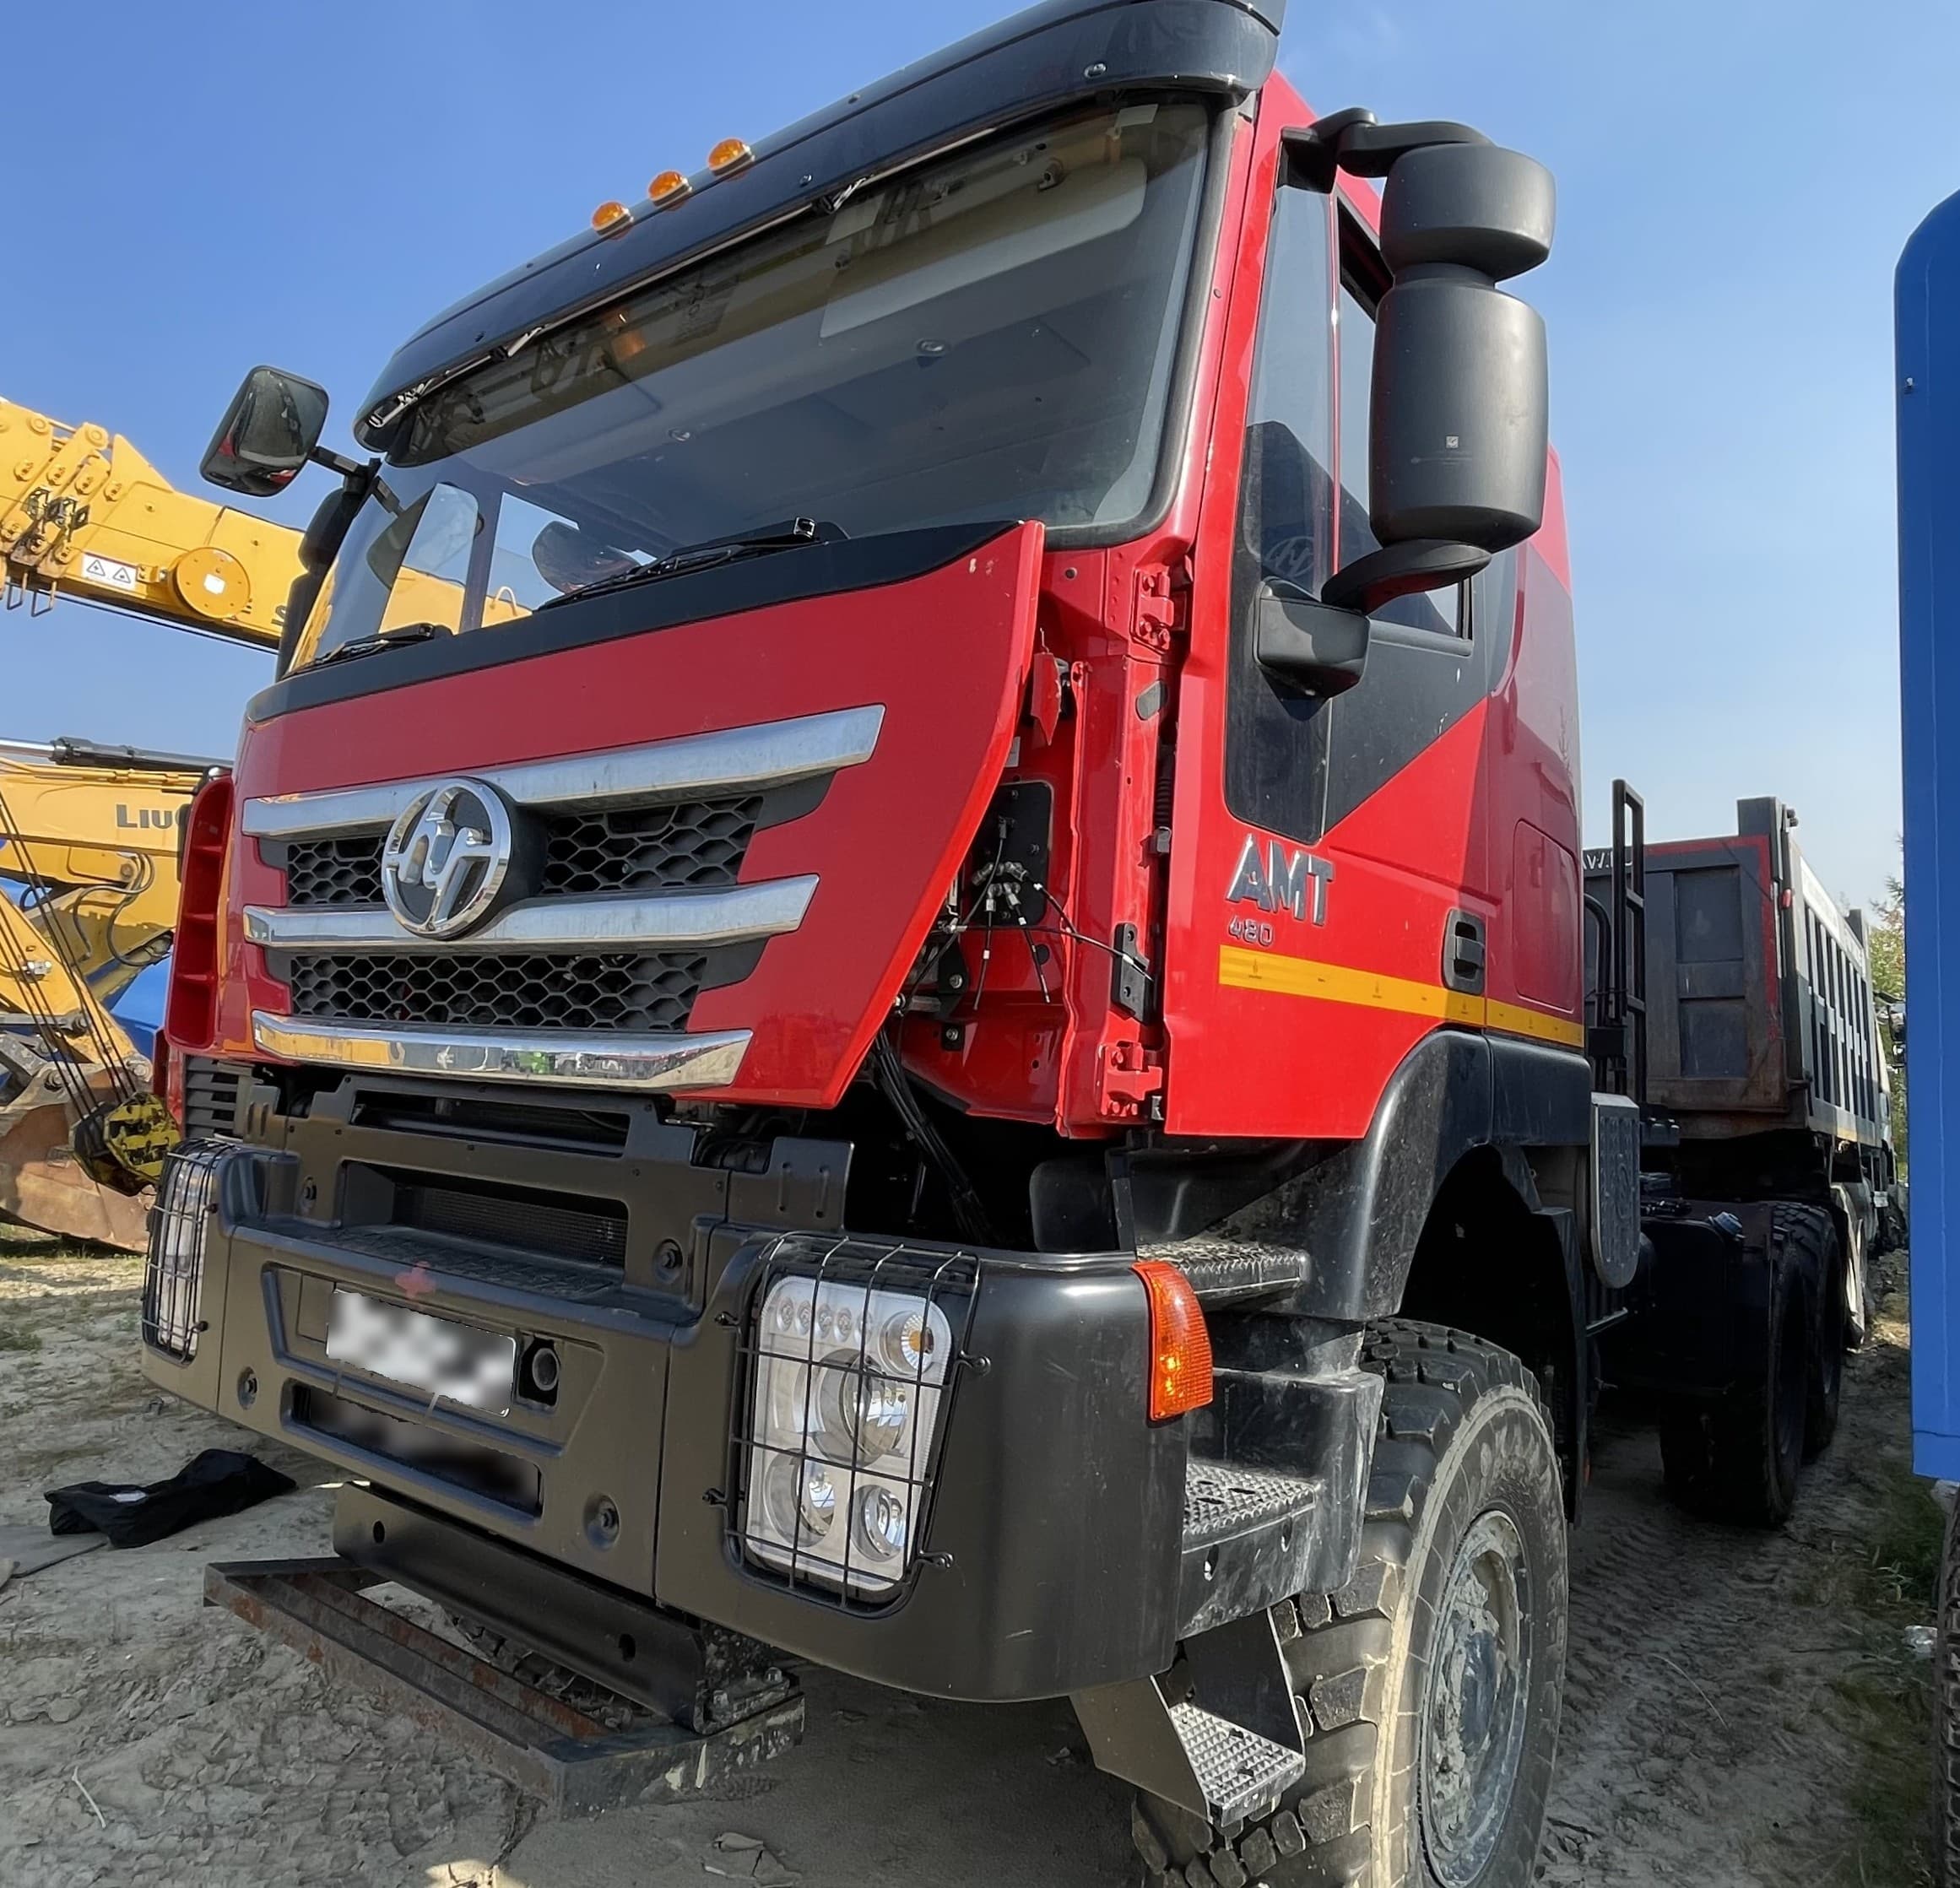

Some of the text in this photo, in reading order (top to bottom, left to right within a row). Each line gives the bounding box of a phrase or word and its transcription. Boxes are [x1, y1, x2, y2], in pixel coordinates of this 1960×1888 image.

[116, 804, 180, 829] LIU
[1226, 832, 1334, 927] AMT
[1228, 916, 1273, 946] 480
